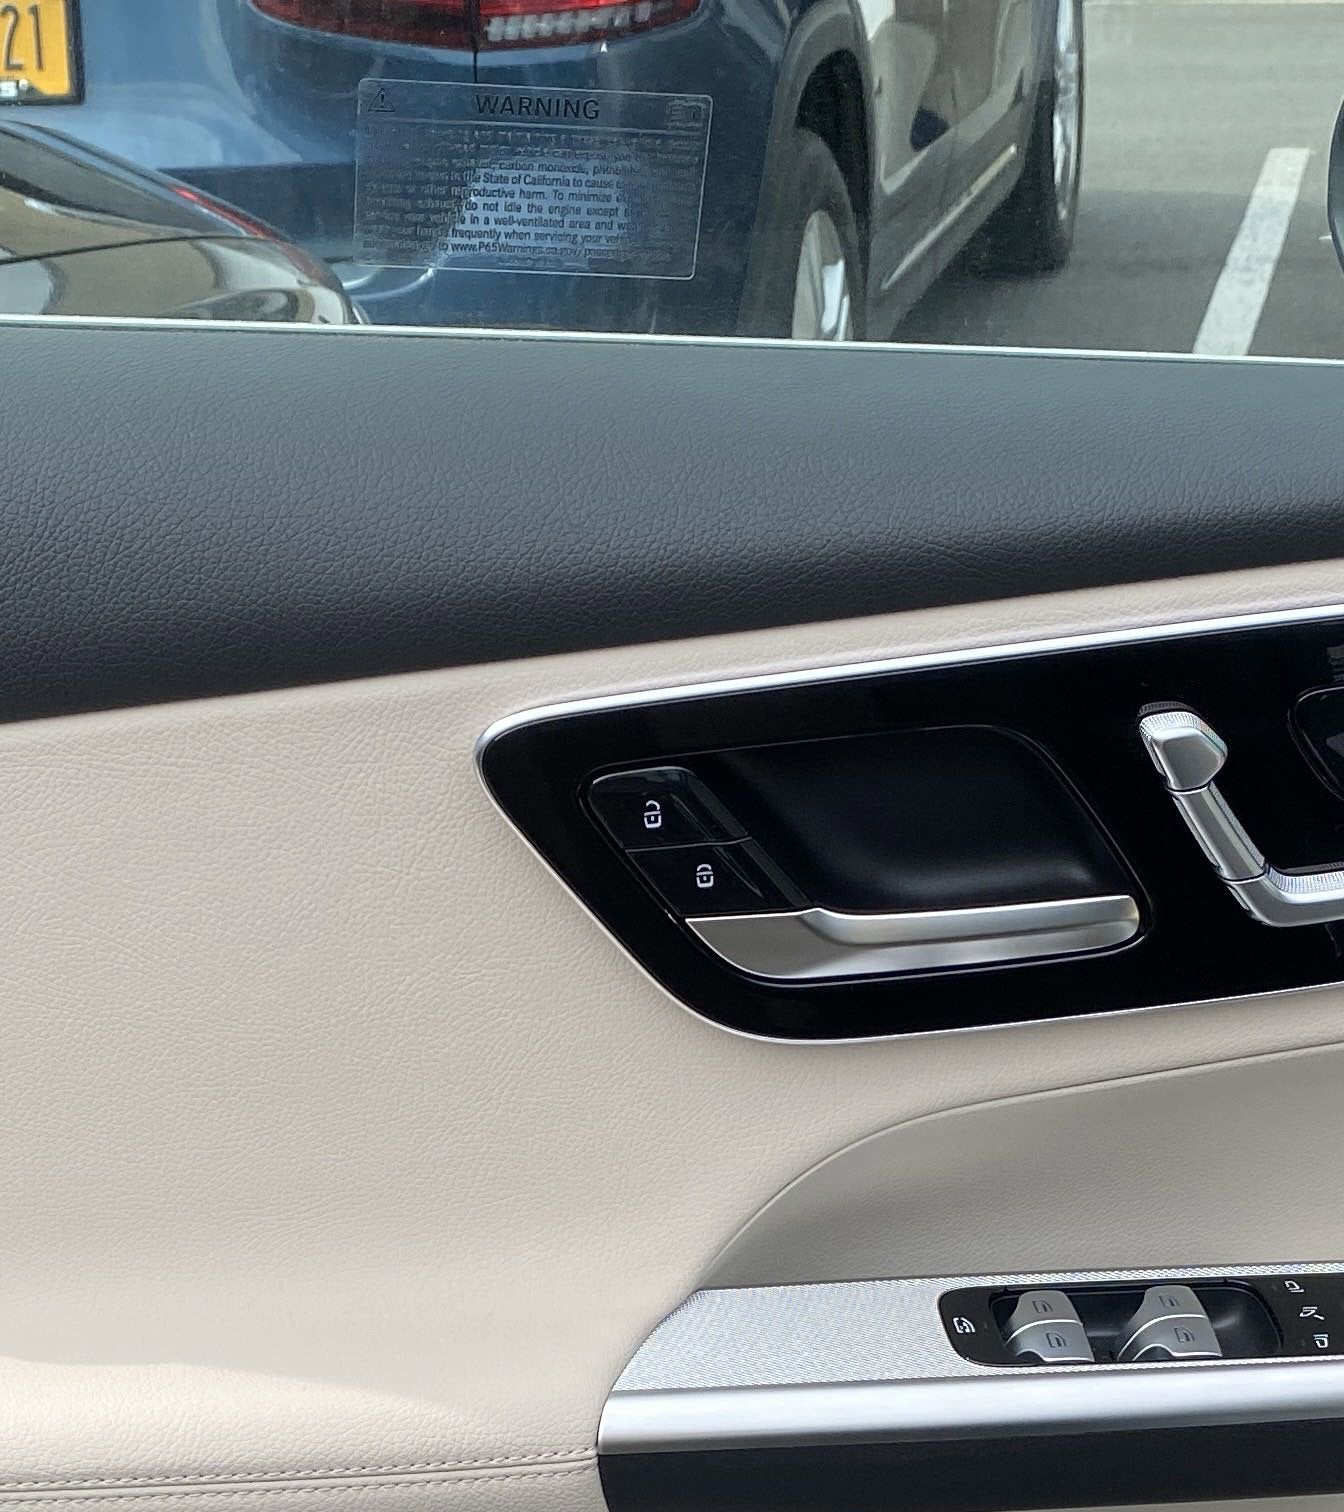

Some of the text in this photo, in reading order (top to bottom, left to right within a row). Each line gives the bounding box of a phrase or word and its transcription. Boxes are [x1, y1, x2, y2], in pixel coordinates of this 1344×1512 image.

[476, 94, 601, 120] WARNING
[483, 173, 510, 184] State
[511, 173, 522, 184] of
[524, 173, 570, 187] California
[573, 177, 583, 188] to
[553, 190, 564, 200] To
[568, 191, 613, 203] minimize
[465, 202, 477, 212] do
[483, 203, 499, 213] not
[504, 203, 522, 213] idle
[527, 204, 543, 214] the
[548, 206, 582, 218] engine
[587, 208, 620, 219] except
[470, 215, 480, 225] in
[494, 216, 565, 230] well-ventilated
[569, 219, 591, 230] area
[595, 220, 614, 231] and
[451, 227, 502, 241] frequently
[504, 230, 530, 239] when
[534, 232, 578, 245] servicing
[581, 234, 603, 245] your
